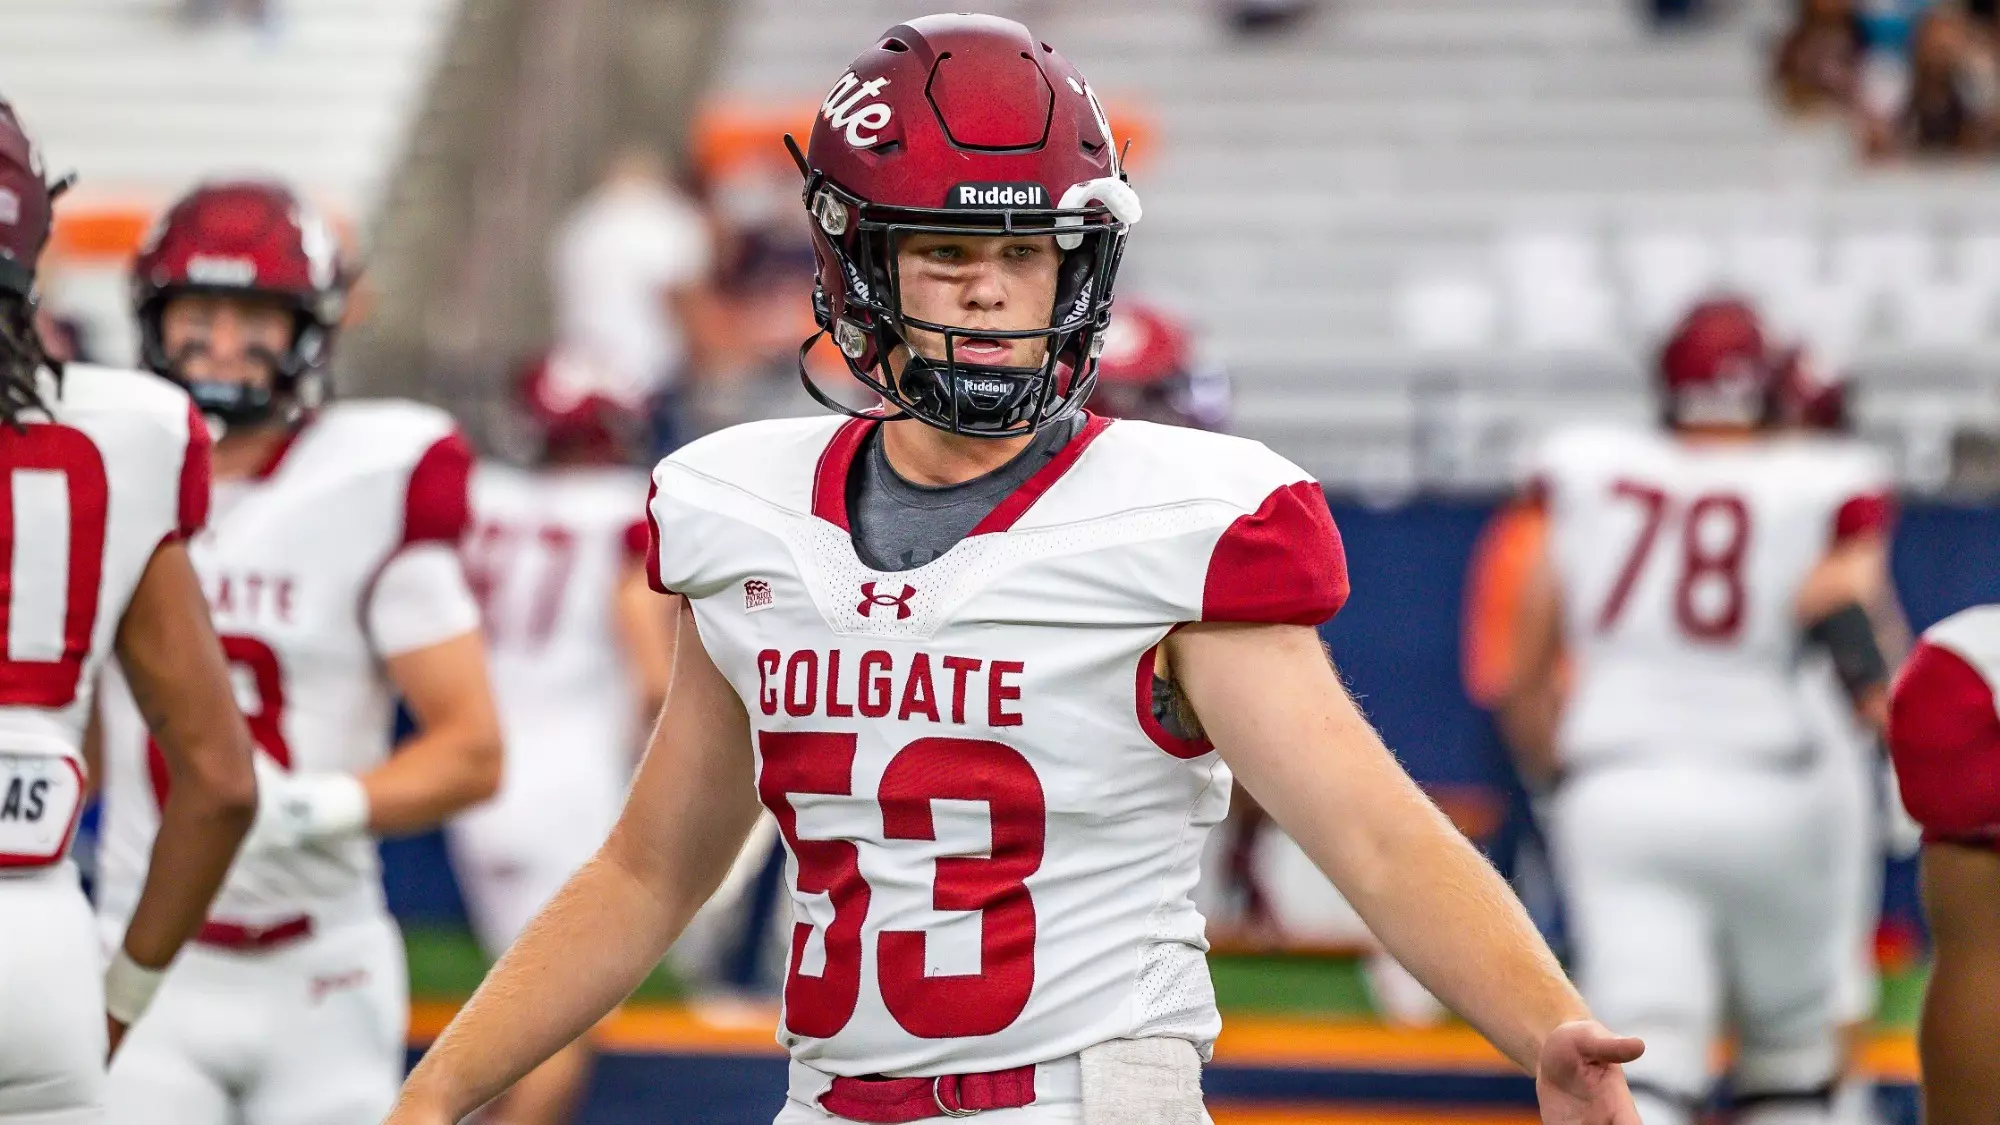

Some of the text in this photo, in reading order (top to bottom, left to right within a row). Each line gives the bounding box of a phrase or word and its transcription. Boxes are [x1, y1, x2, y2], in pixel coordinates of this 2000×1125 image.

[959, 185, 1041, 205] Riddell
[964, 380, 1007, 393] Riddell
[1596, 479, 1750, 644] 78
[757, 648, 1025, 727] COLGATE
[0, 777, 48, 821] AS
[758, 729, 1046, 1039] 53
